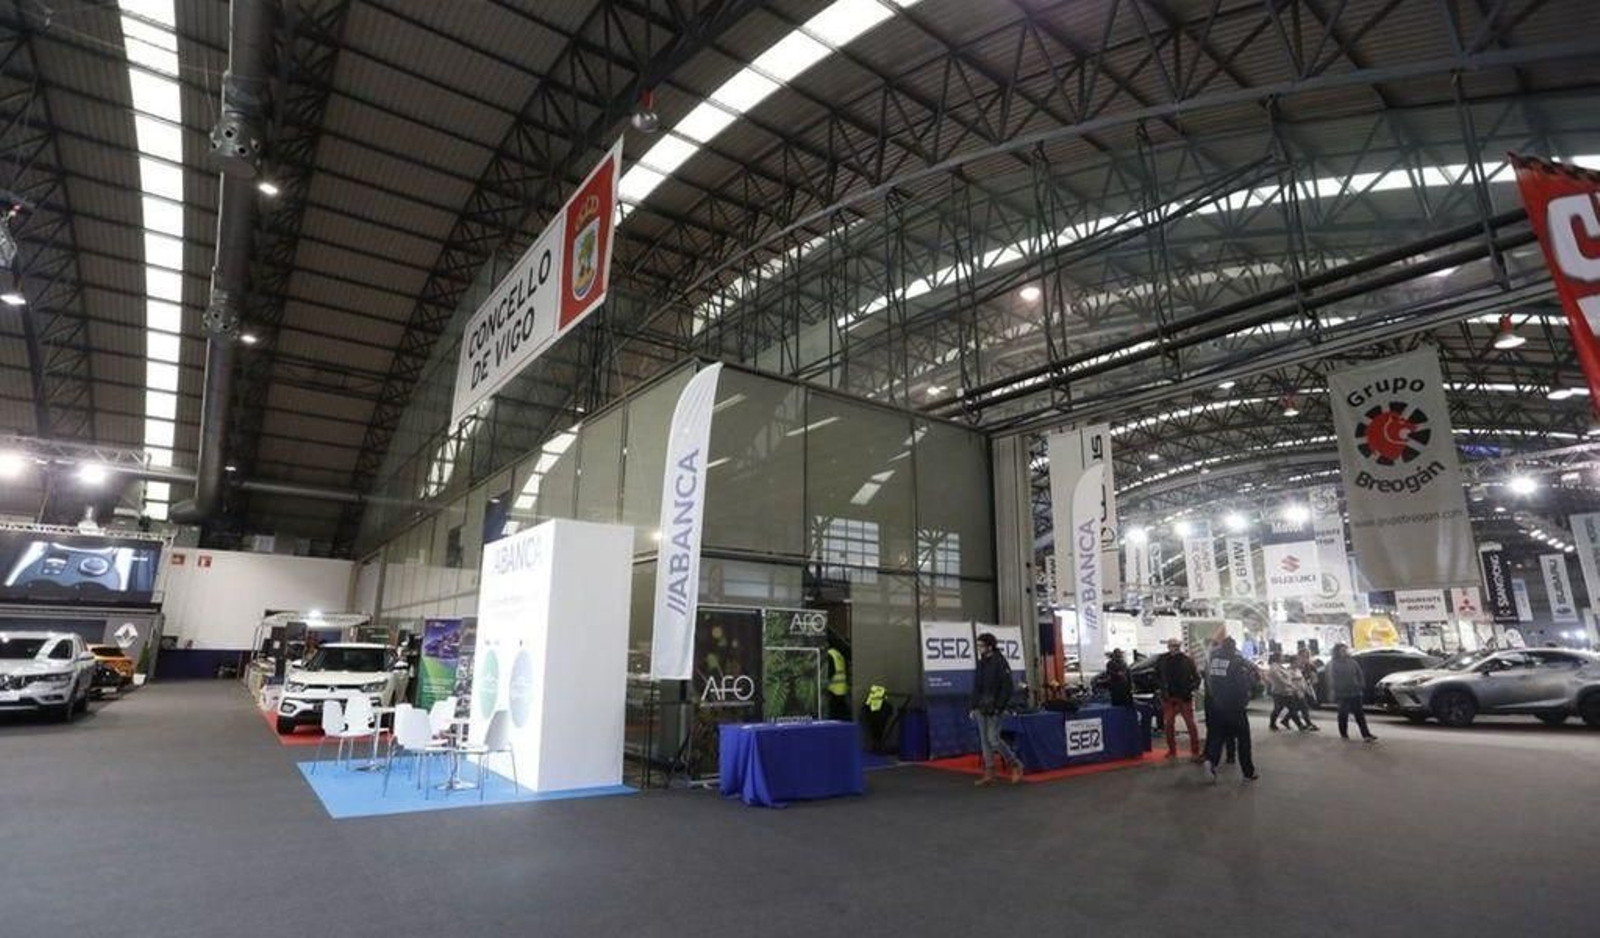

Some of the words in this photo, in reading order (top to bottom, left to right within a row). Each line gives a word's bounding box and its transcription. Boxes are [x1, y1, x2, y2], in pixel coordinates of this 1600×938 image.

[468, 249, 551, 360] CONCELLO
[470, 353, 490, 391] DE
[495, 306, 535, 368] VIGO
[1347, 377, 1425, 407] Grupo
[1355, 461, 1446, 493] Breogán
[1271, 574, 1316, 585] SUZUKI
[789, 613, 826, 632] AFO
[925, 637, 971, 659] SER
[997, 639, 1021, 660] ER
[700, 675, 755, 701] AFO
[1069, 729, 1100, 751] SER
